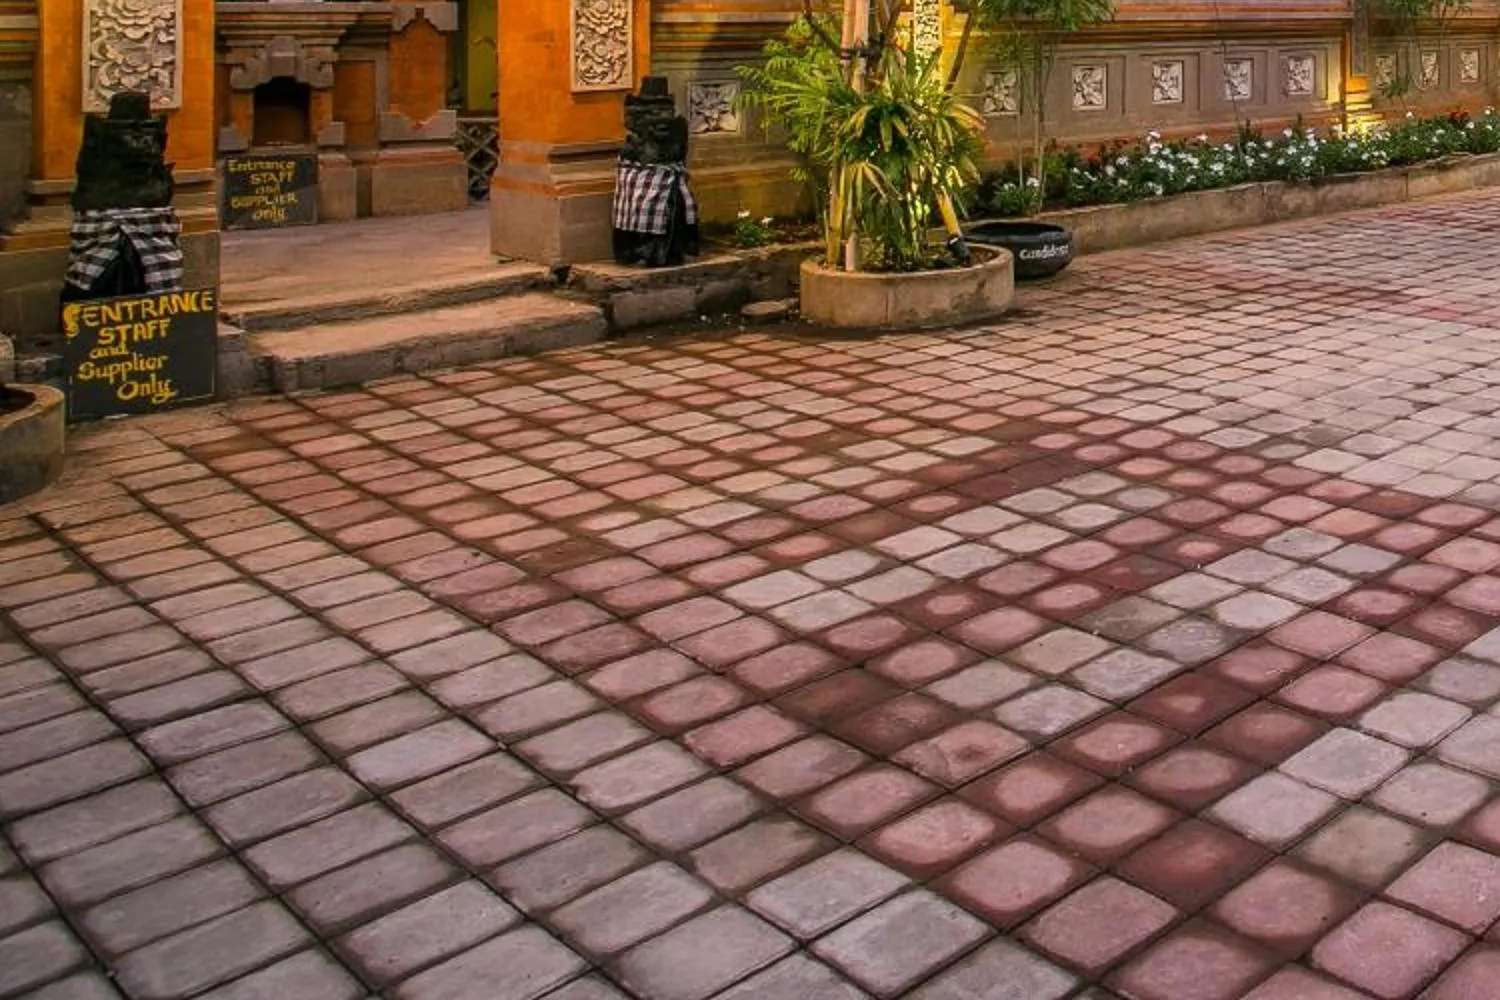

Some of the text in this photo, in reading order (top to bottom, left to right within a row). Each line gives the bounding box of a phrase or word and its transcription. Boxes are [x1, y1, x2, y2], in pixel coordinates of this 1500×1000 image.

[98, 318, 171, 345] STAFF
[90, 343, 129, 359] and
[117, 374, 179, 404] Only
